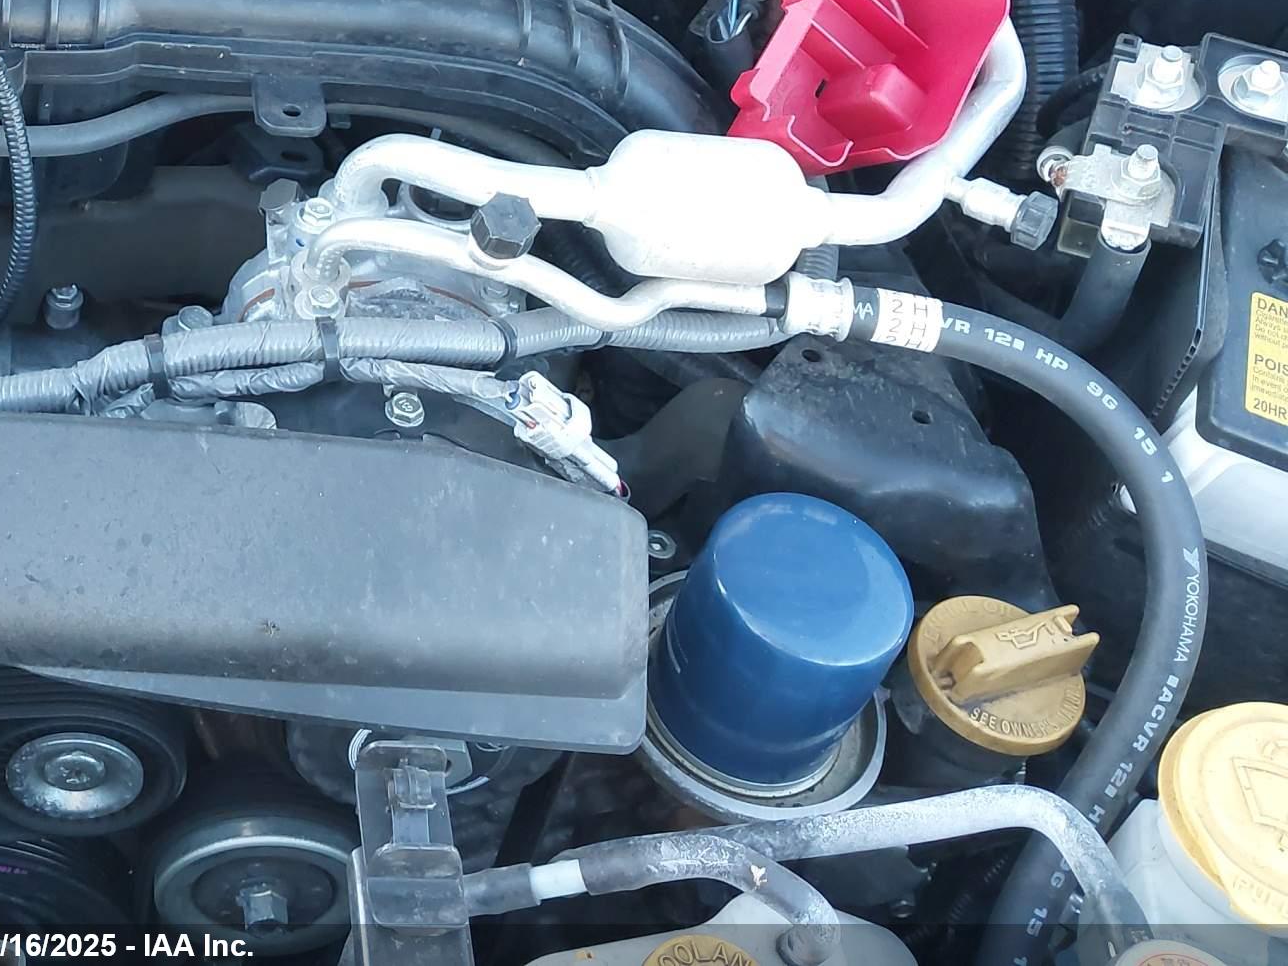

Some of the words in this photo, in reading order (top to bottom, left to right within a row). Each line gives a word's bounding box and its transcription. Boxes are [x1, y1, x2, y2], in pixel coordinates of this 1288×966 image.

[1035, 347, 1069, 372] HP
[1086, 380, 1119, 411] 9G
[1133, 426, 1158, 457] 15
[1173, 573, 1201, 663] YOKOHAMA
[970, 706, 998, 730] SEE
